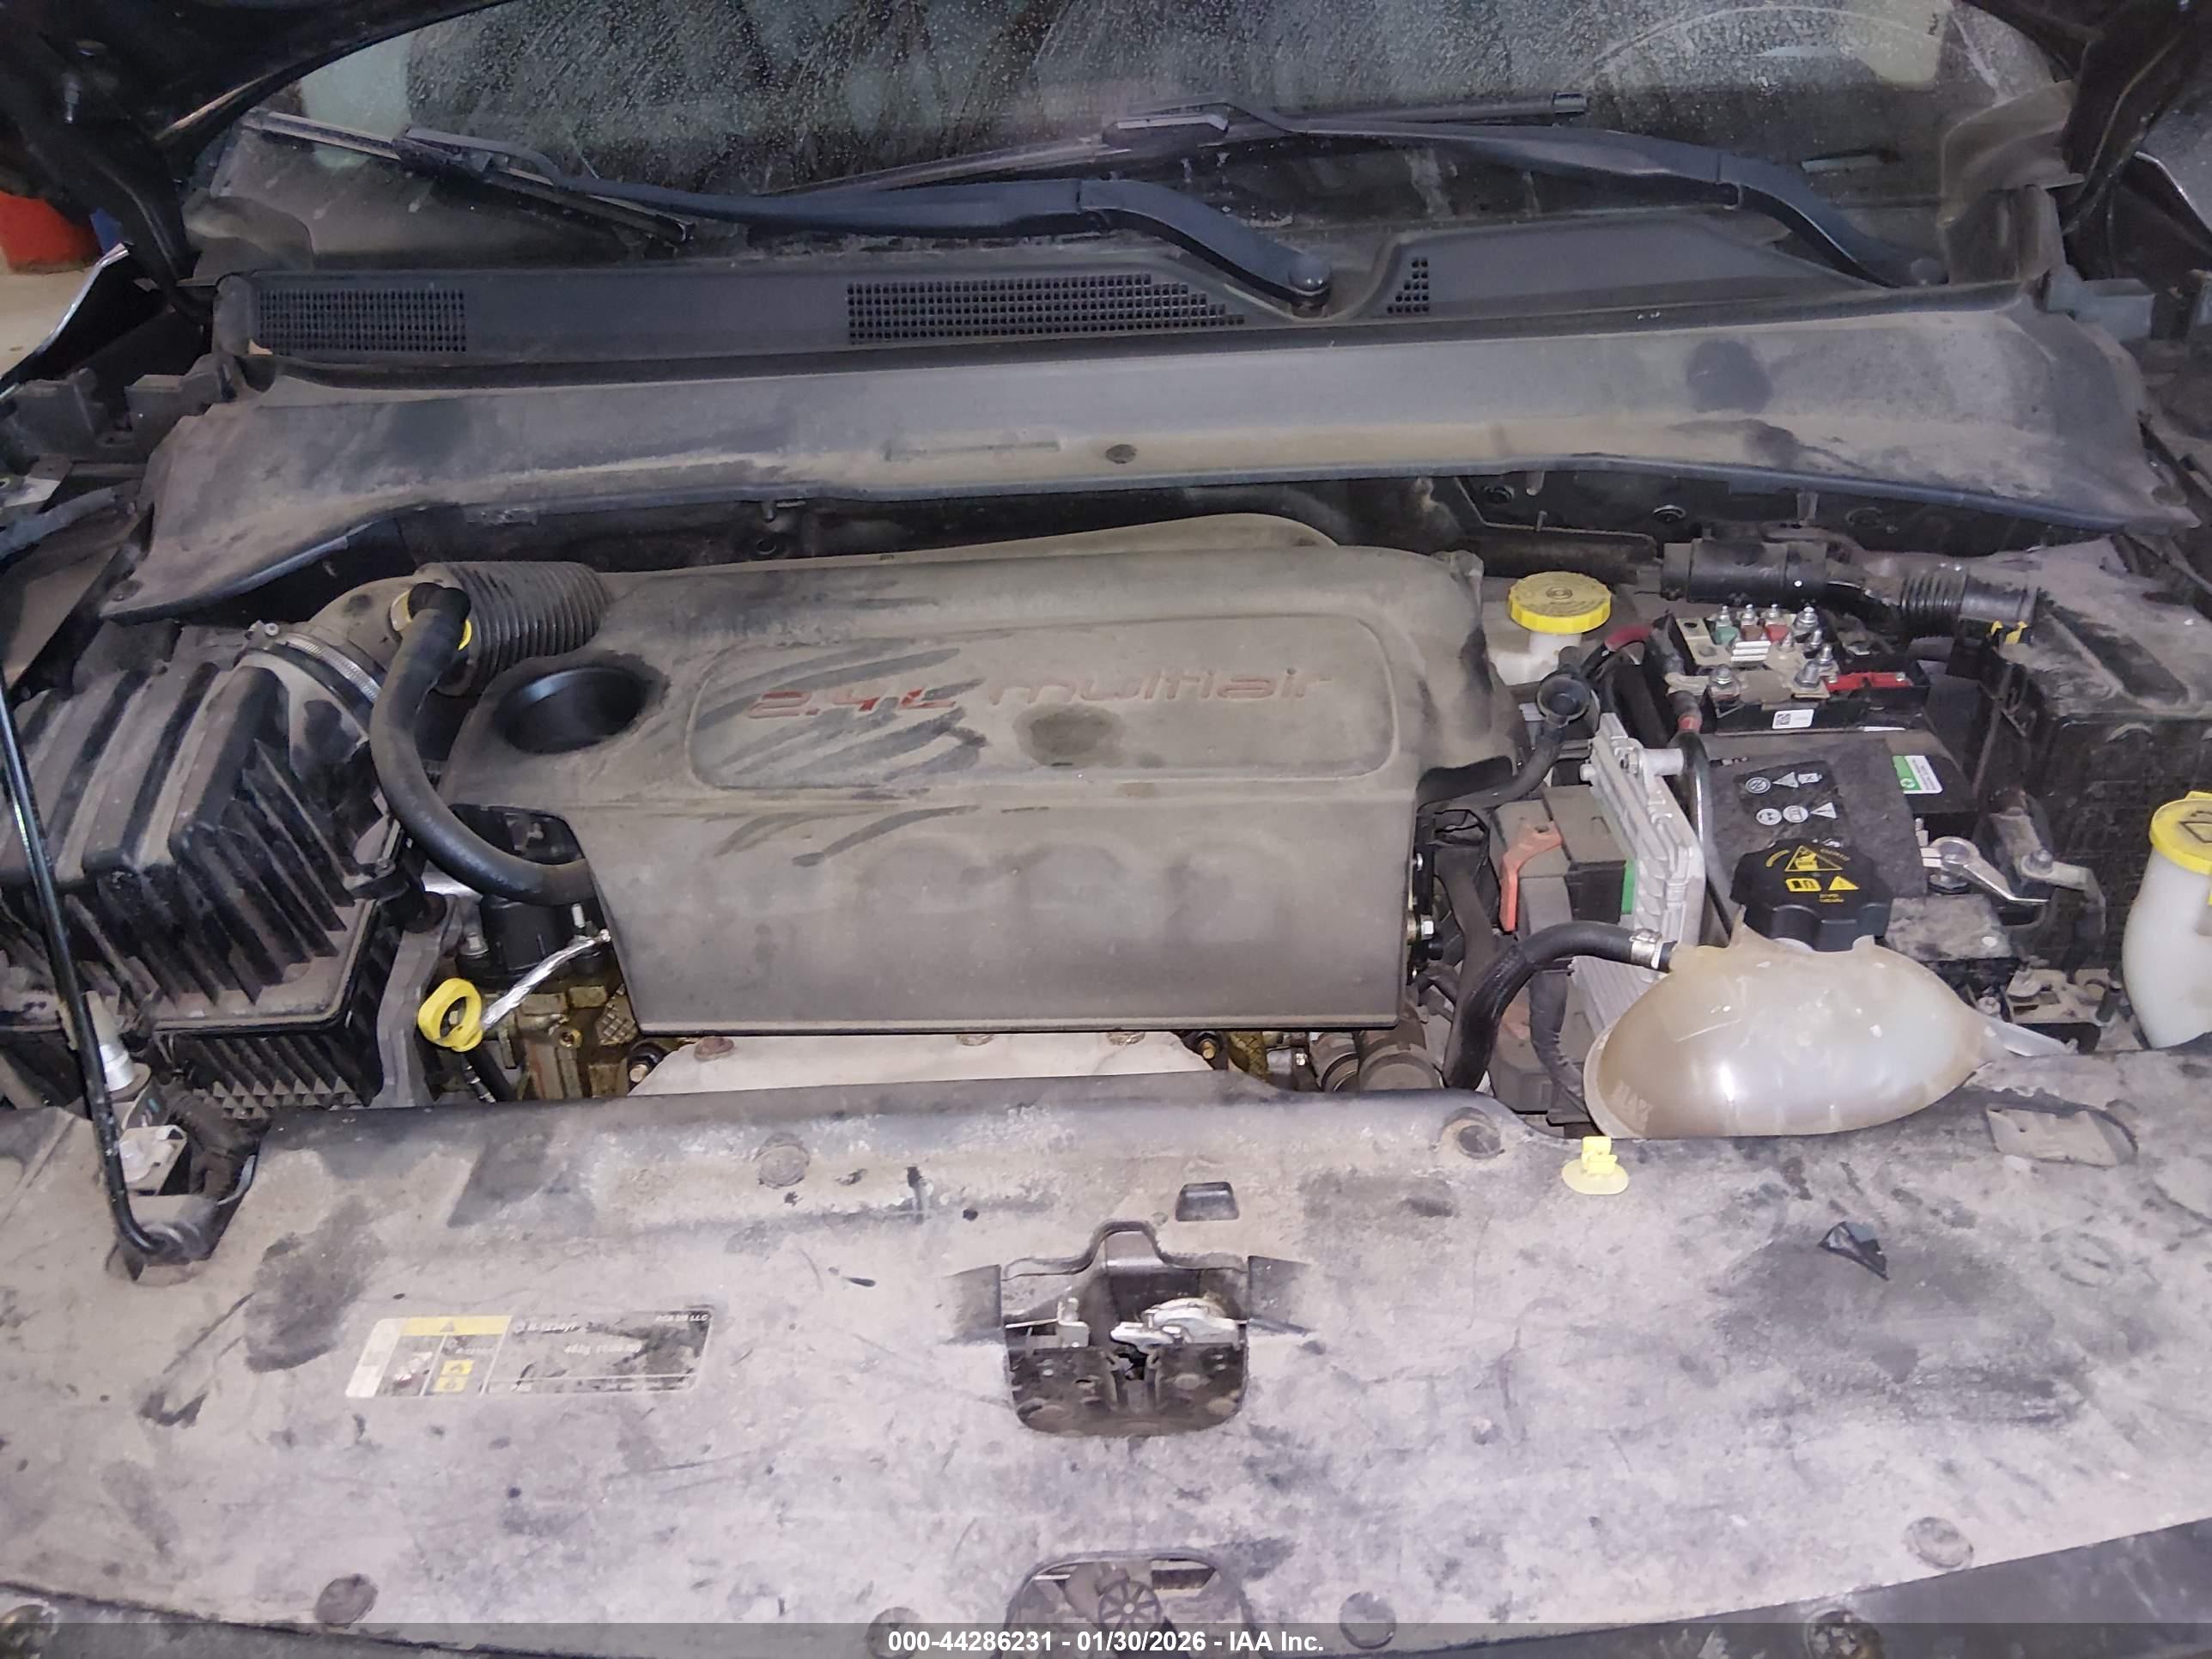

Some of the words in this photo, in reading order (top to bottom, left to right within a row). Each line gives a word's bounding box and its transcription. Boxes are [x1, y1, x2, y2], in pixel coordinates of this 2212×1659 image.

[749, 687, 956, 719] 2.4L
[988, 668, 1334, 706] multiair
[690, 1313, 708, 1322] LLC
